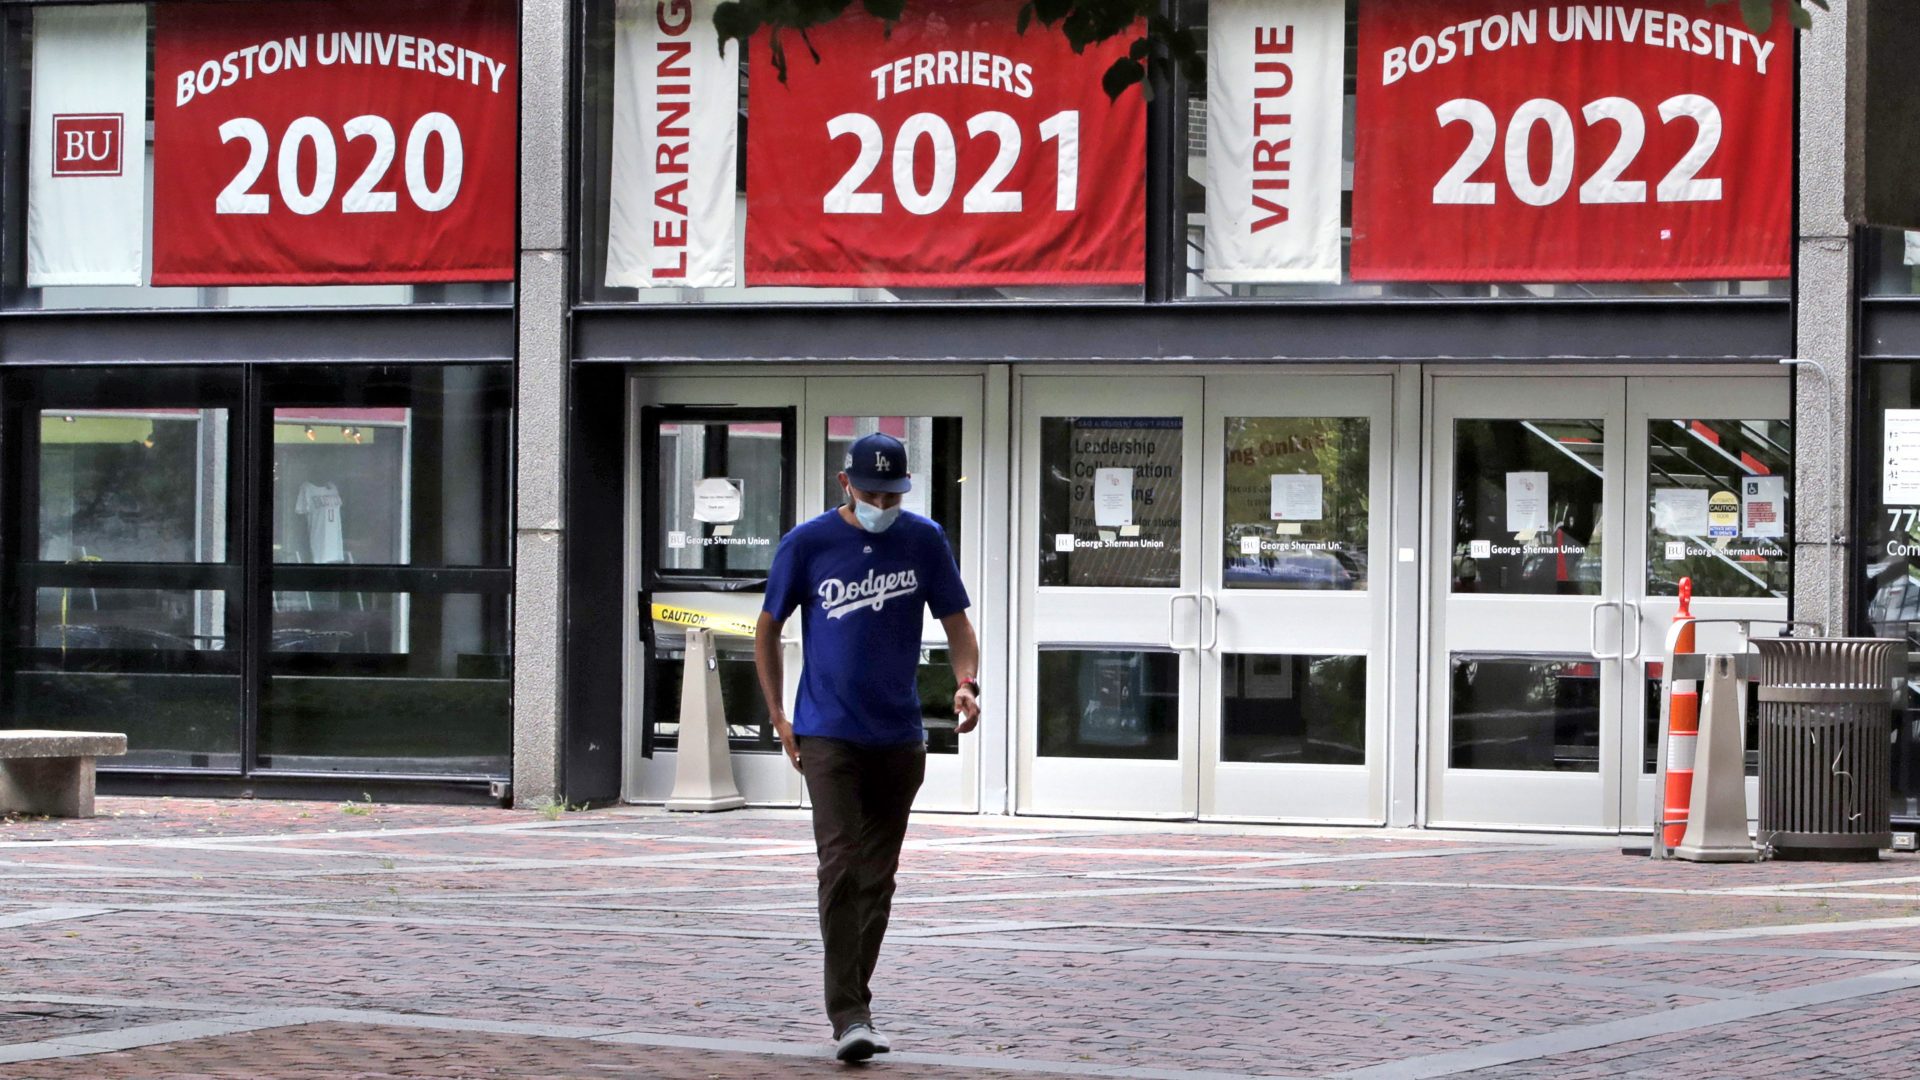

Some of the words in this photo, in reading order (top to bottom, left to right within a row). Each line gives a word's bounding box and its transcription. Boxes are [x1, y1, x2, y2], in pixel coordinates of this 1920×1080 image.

[1382, 10, 1537, 86] BOSTON
[1548, 5, 1775, 75] UNIVERSITY
[176, 35, 307, 107] BOSTON
[316, 32, 507, 93] UNIVERSITY
[871, 50, 1033, 100] TERRIERS
[651, 0, 692, 279] LEARNING
[1250, 25, 1294, 234] VIRTUE
[63, 130, 112, 161] BU
[1432, 94, 1724, 206] 2022
[216, 112, 463, 215] 2020
[823, 110, 1079, 215] 2021
[875, 451, 890, 472] LA
[1075, 439, 1155, 457] Leadership
[1709, 504, 1737, 512] CAUTION
[1887, 509, 1920, 532] 77
[686, 536, 712, 545] George
[714, 536, 746, 545] Sherman
[748, 536, 770, 545] Union
[1074, 539, 1103, 549] George
[1104, 539, 1139, 548] Sherman
[1140, 539, 1164, 548] Union
[1260, 541, 1289, 551] George
[1291, 541, 1326, 550] Sherman
[1491, 545, 1521, 555] George
[1523, 545, 1559, 554] Sherman
[1561, 545, 1585, 554] Union
[1686, 546, 1715, 557] George
[1719, 546, 1756, 556] Sherman
[1758, 547, 1783, 556] Union
[818, 568, 919, 614] Dodgers
[661, 608, 708, 625] CAUTION
